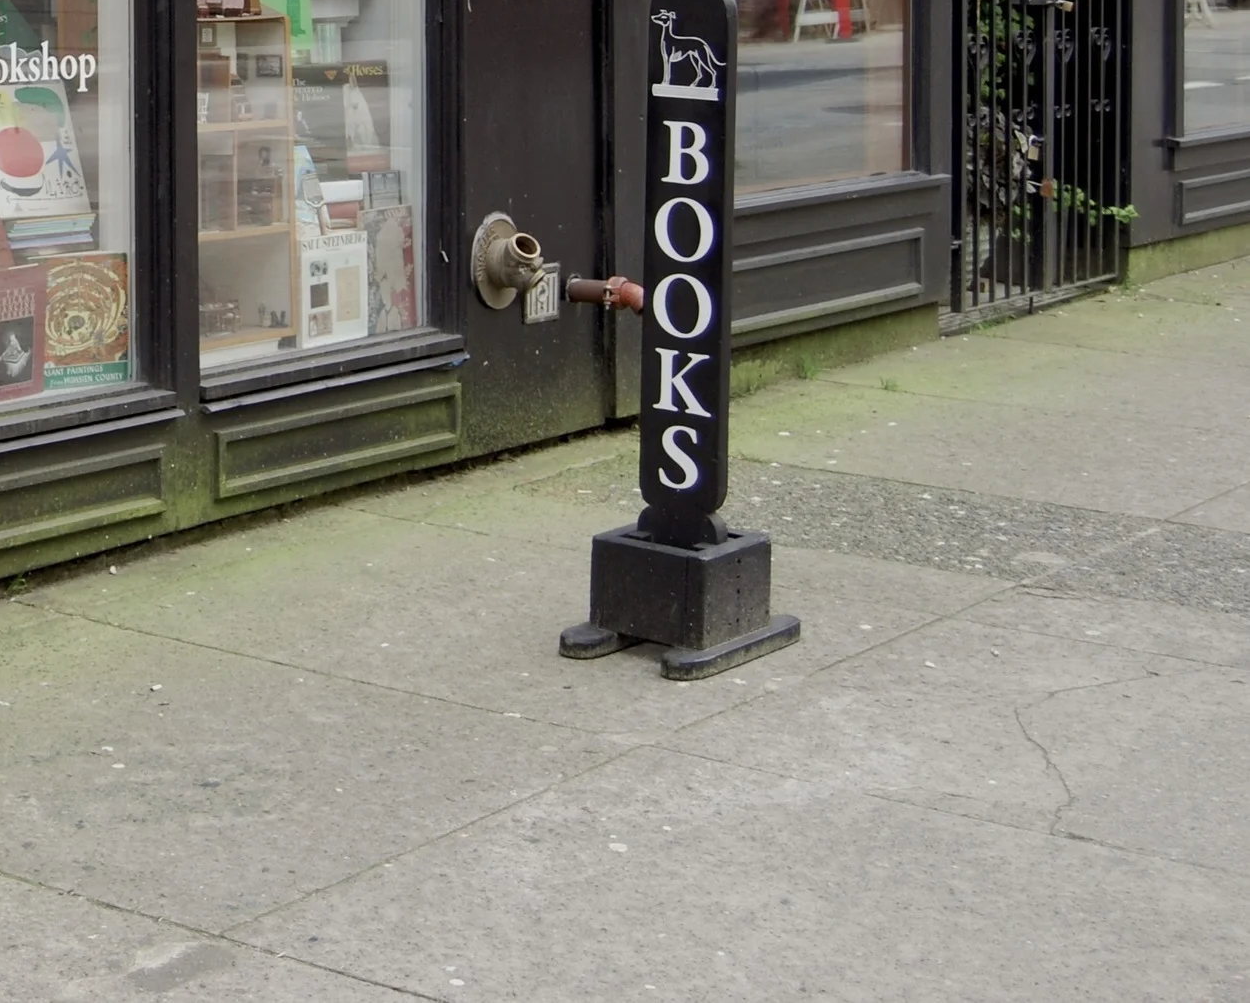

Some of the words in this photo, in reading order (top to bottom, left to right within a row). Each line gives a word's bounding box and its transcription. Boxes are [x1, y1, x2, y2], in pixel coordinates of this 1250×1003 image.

[322, 232, 366, 248] STEINBERG
[652, 119, 716, 490] BOOKS
[44, 368, 65, 377] ASANT
[66, 365, 104, 375] PAINTINGS
[94, 372, 124, 382] COUNTY
